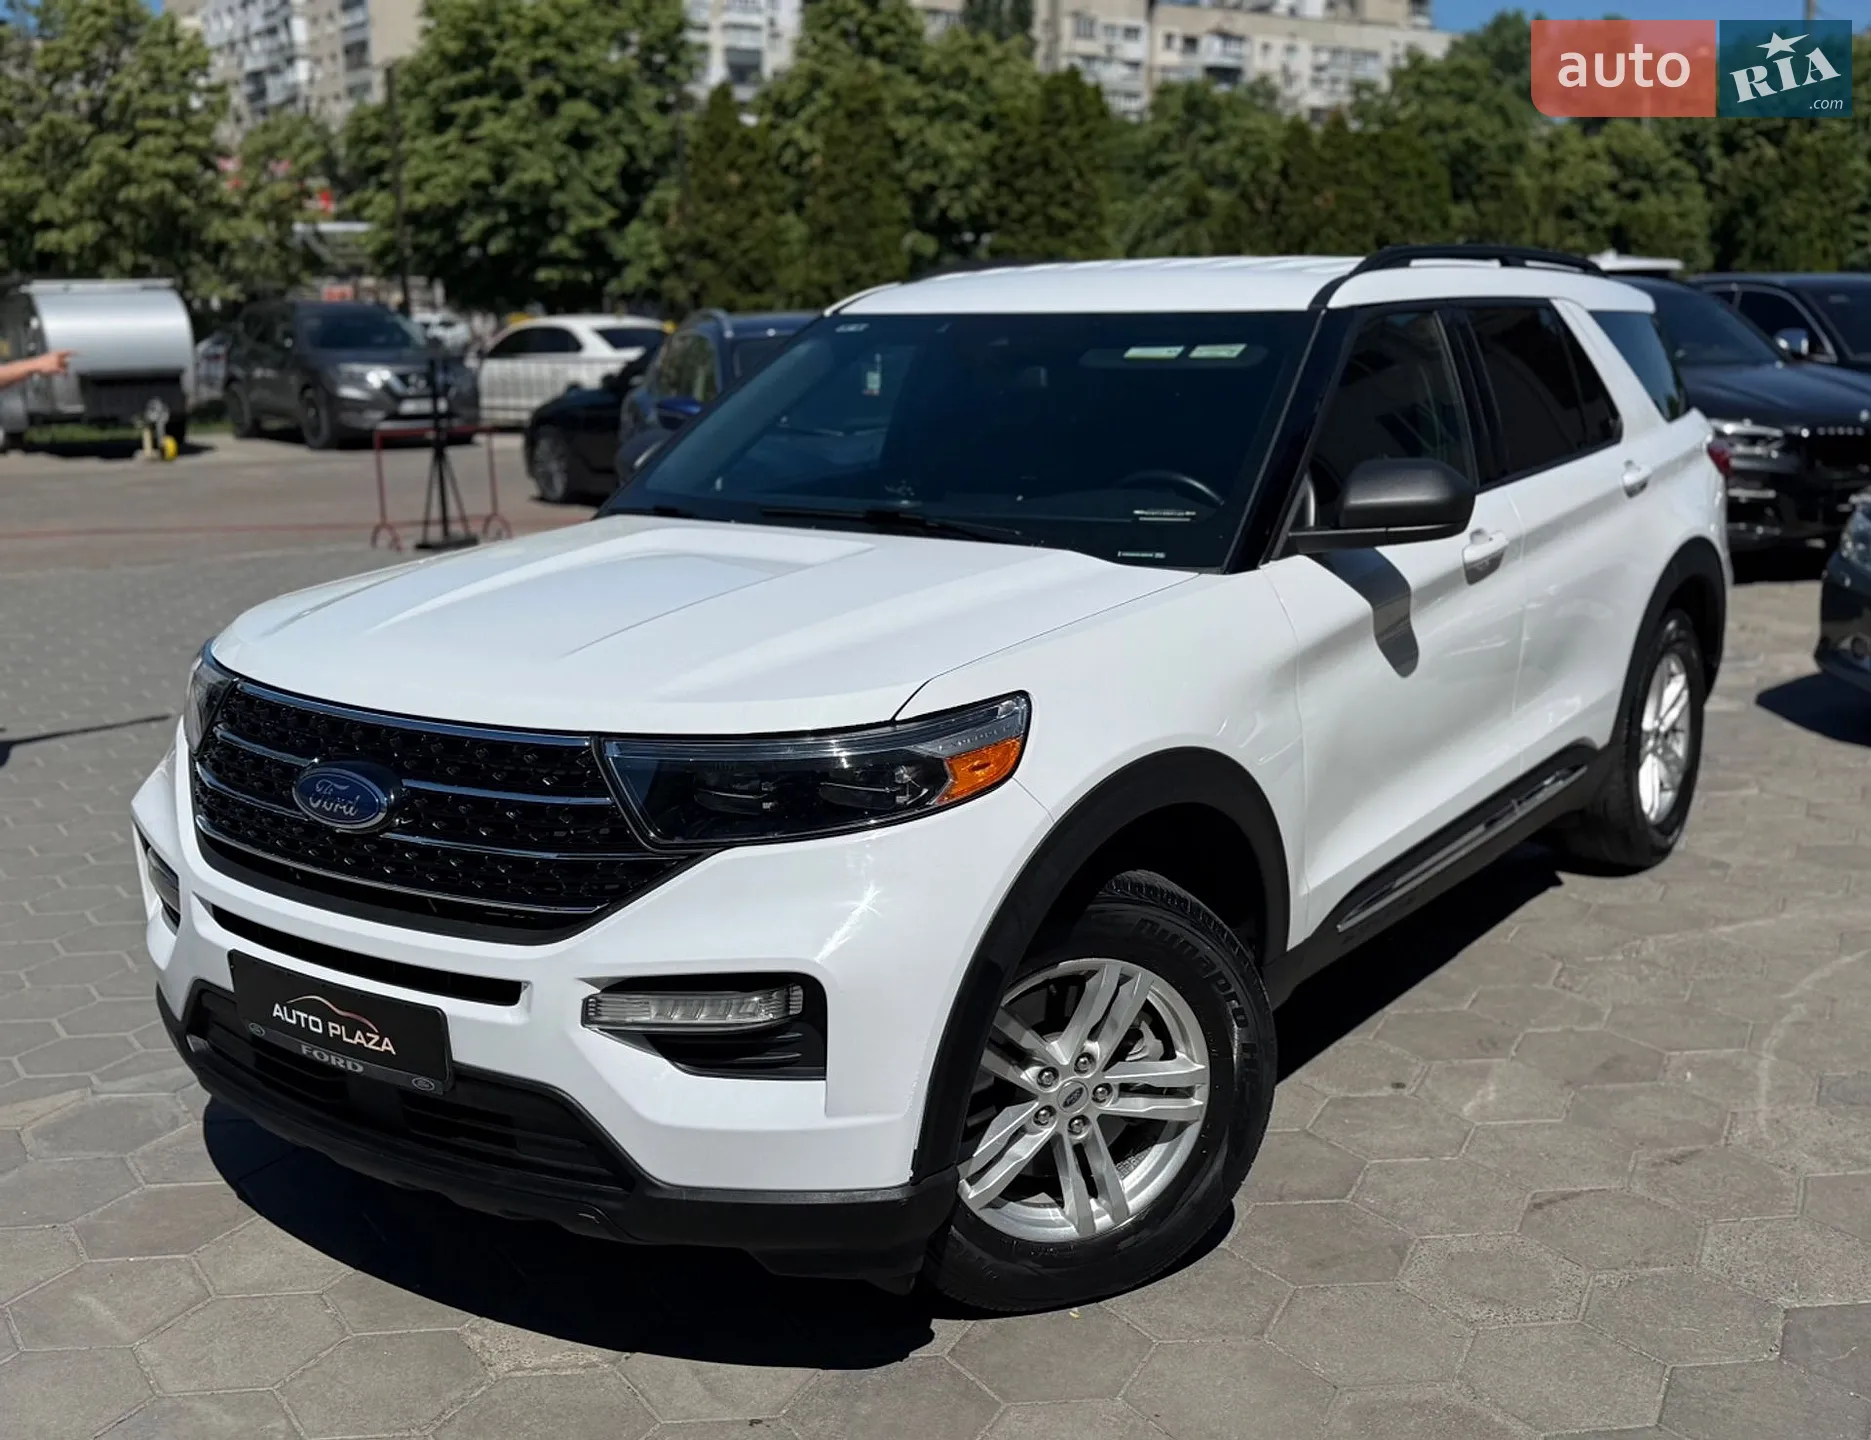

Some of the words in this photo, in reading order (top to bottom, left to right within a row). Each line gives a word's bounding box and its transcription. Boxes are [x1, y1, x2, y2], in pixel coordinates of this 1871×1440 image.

[309, 779, 361, 817] Ford
[272, 1003, 323, 1033] AUTO
[328, 1023, 396, 1055] PLAZA
[300, 1044, 365, 1073] FORD
